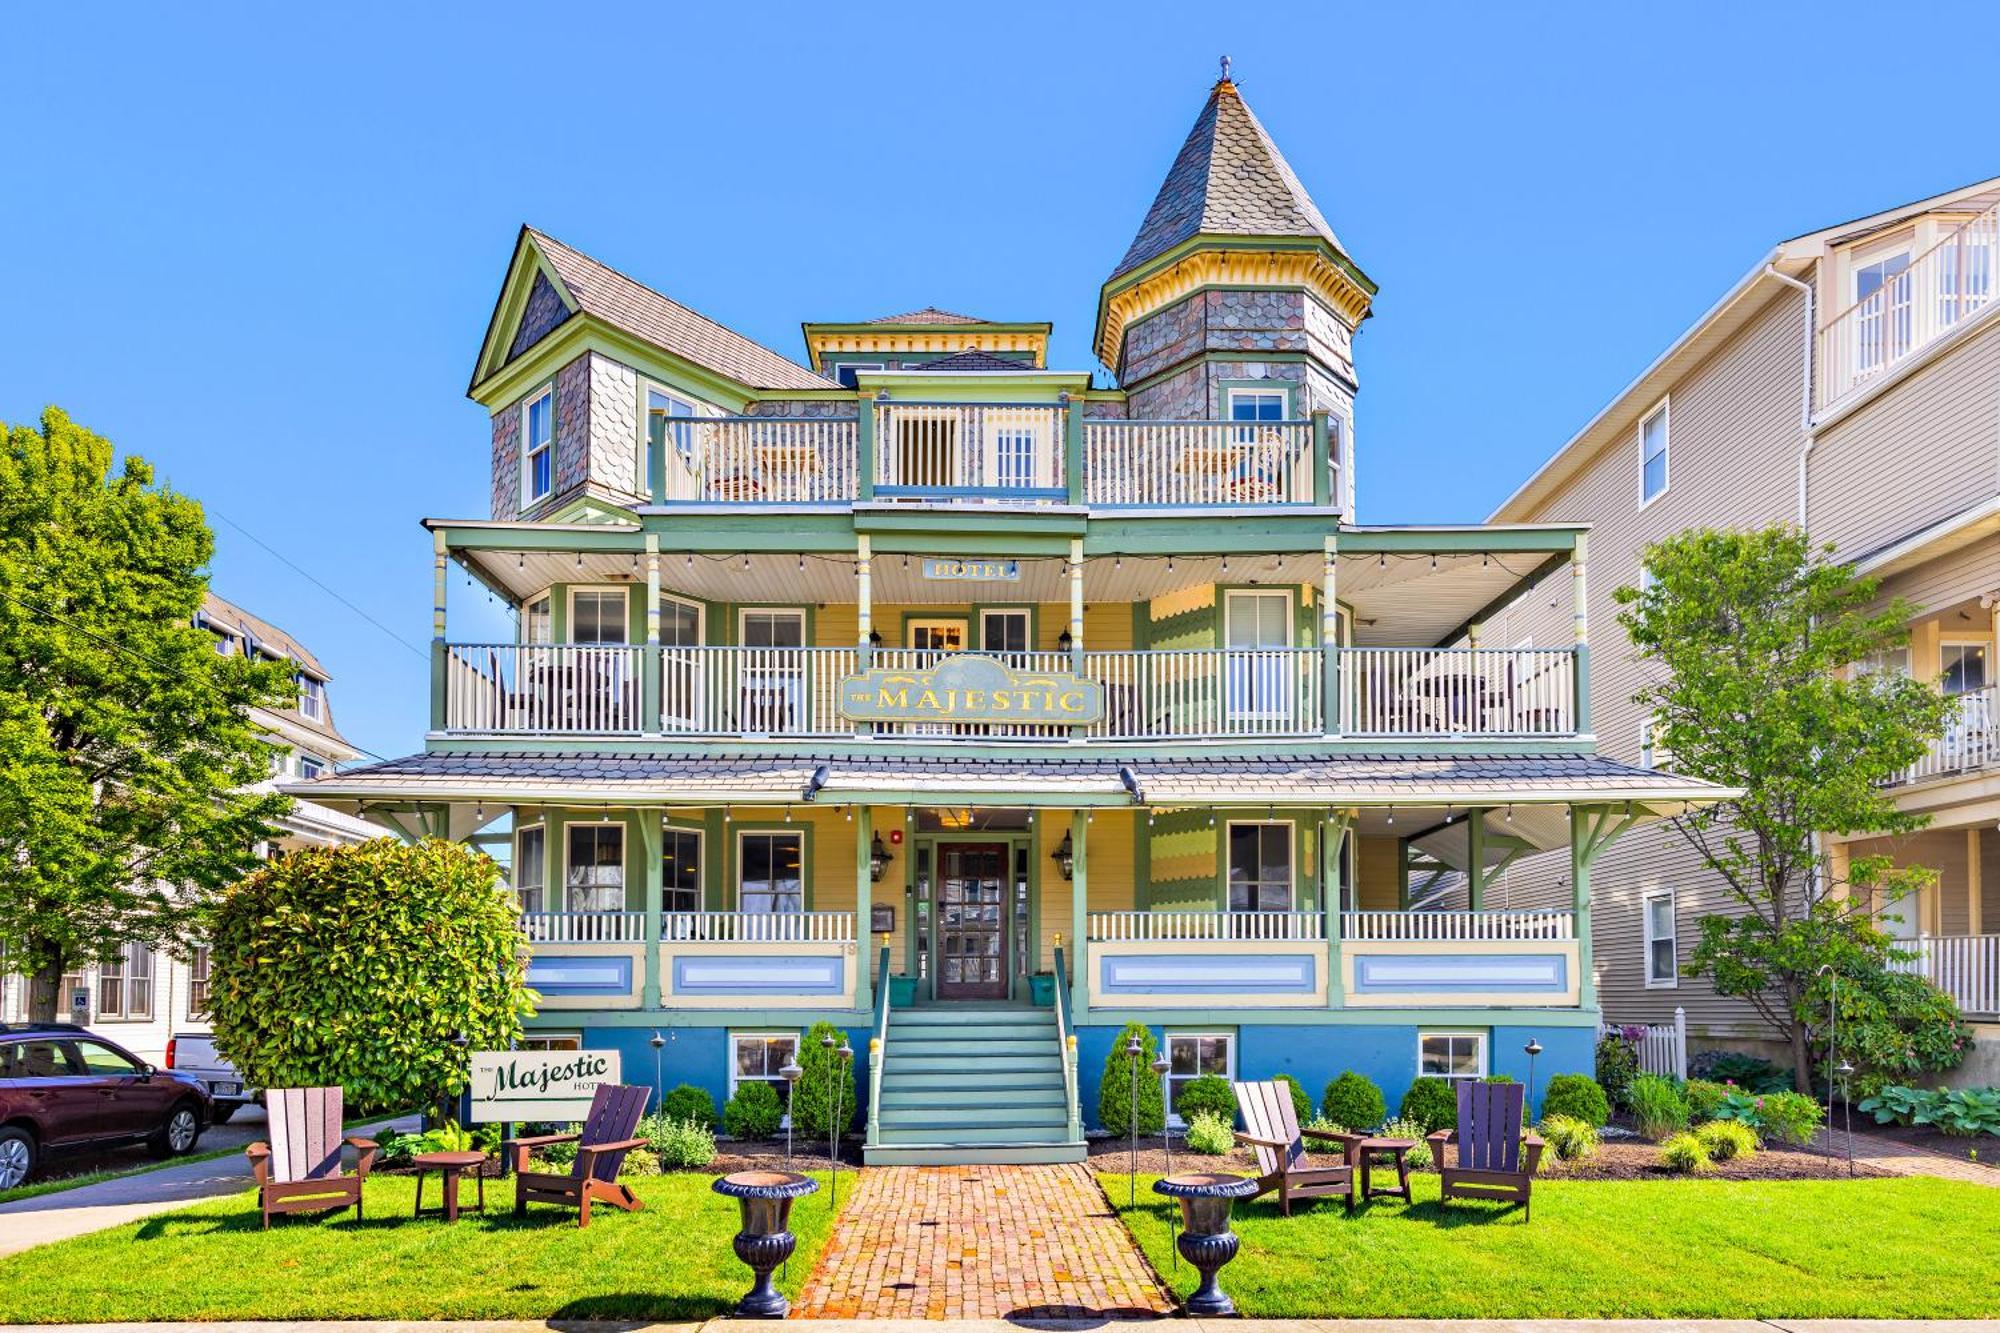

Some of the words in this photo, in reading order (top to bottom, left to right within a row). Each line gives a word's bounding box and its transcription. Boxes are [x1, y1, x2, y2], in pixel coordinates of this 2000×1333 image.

[934, 564, 1009, 577] HOTEL
[850, 693, 873, 703] THE
[876, 688, 1085, 714] MAJESTIC
[486, 1054, 608, 1101] Majestic
[574, 1082, 606, 1090] HOT
